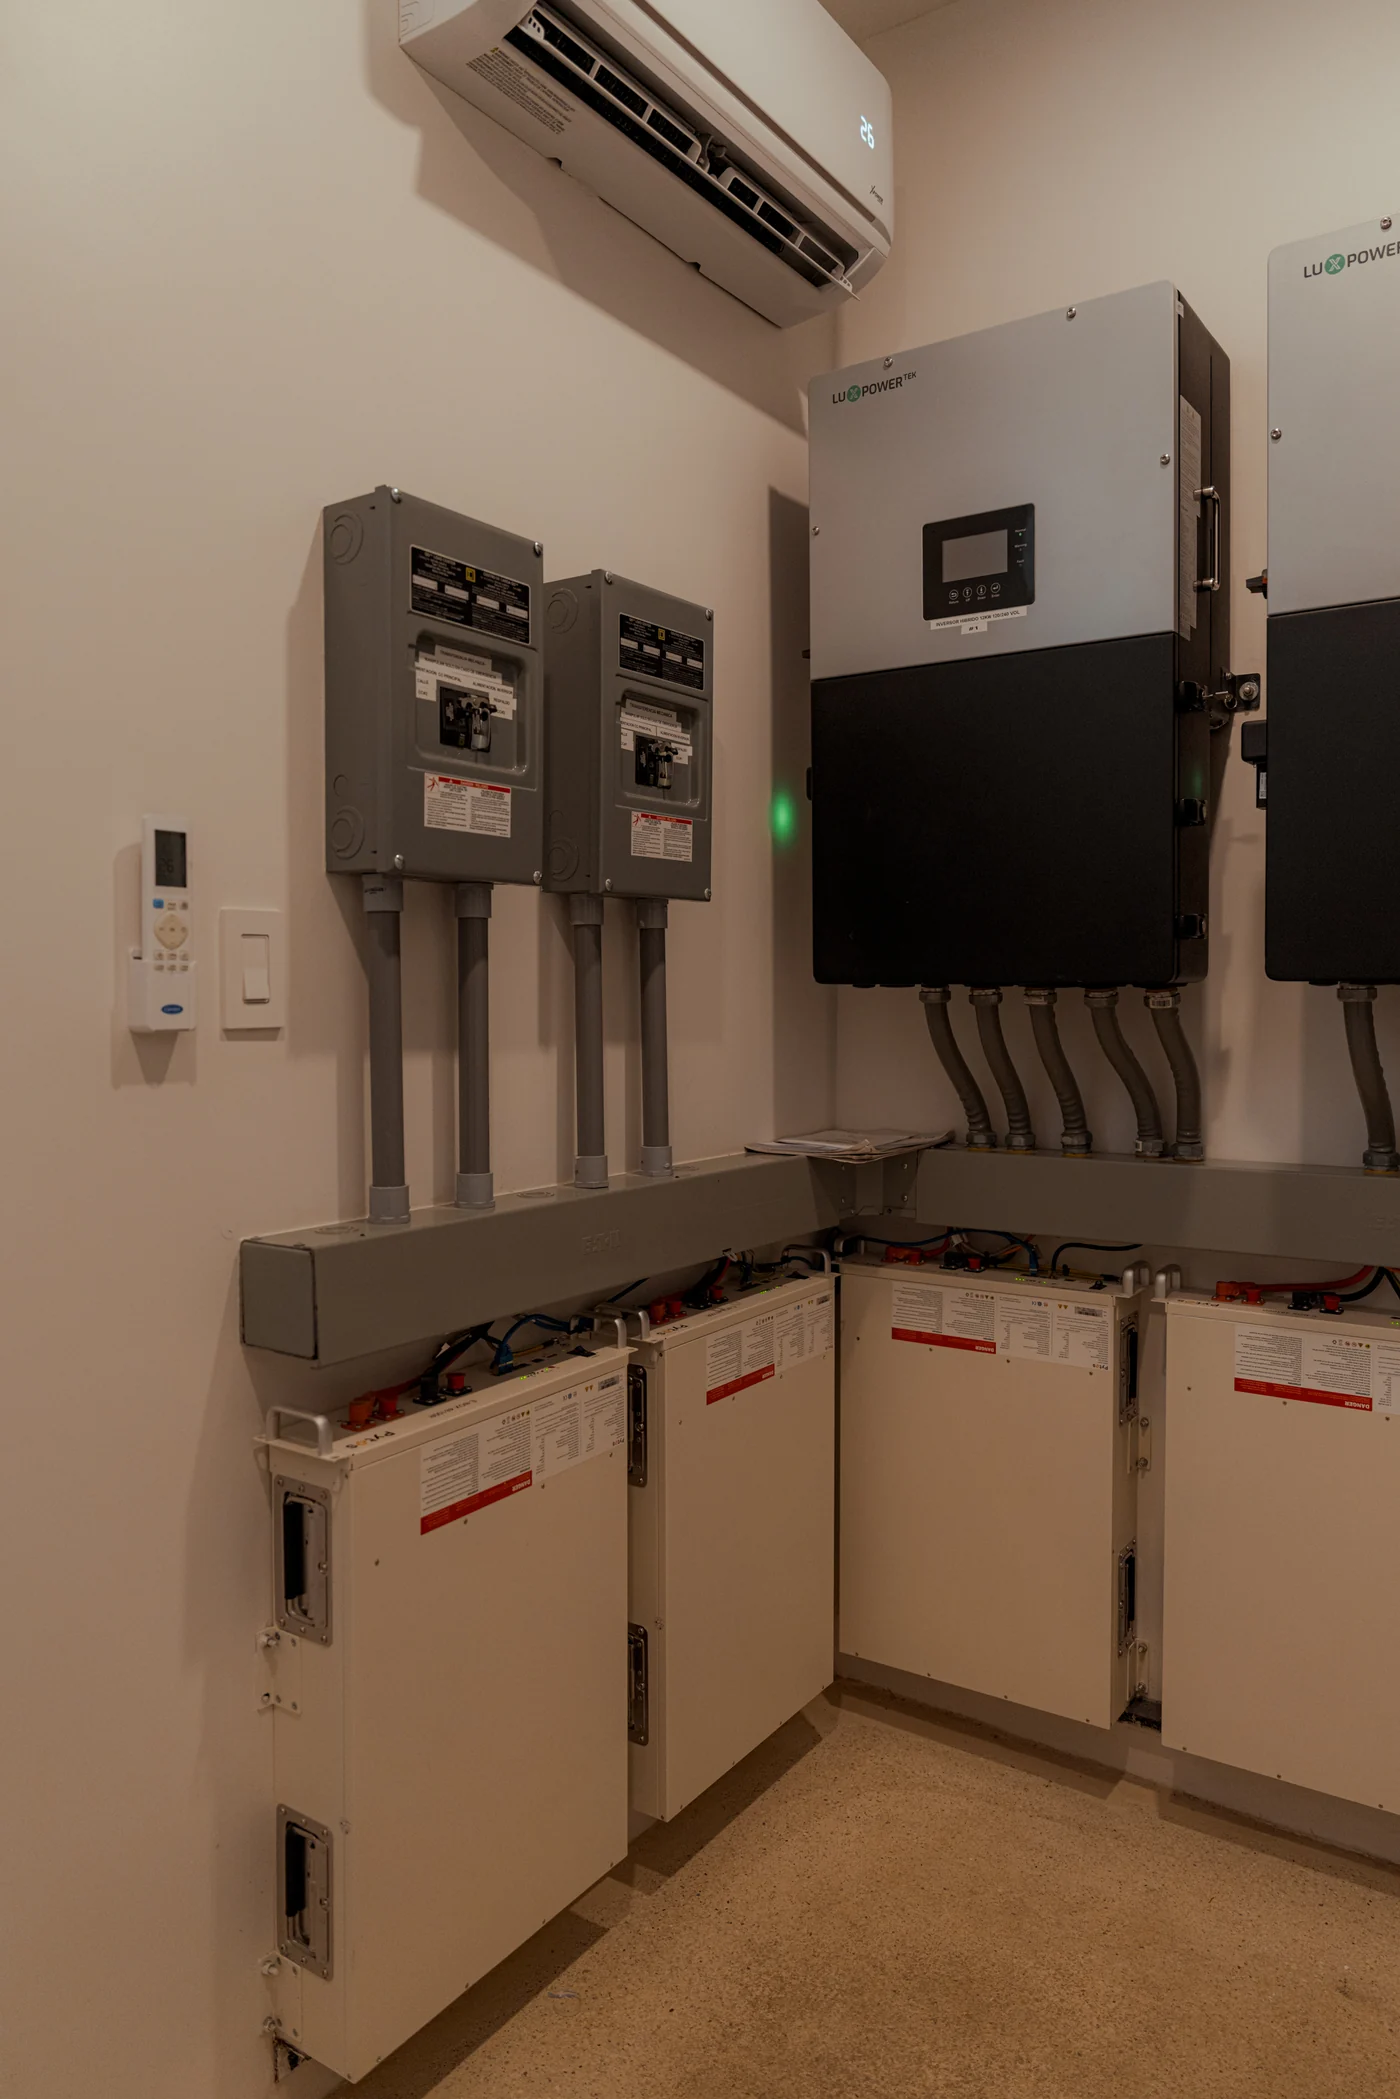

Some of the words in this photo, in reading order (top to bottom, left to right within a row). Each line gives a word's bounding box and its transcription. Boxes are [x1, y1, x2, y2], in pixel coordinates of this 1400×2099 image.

[860, 115, 875, 149] 26
[975, 1345, 994, 1353] DANGER
[1345, 1400, 1370, 1409] DANGER
